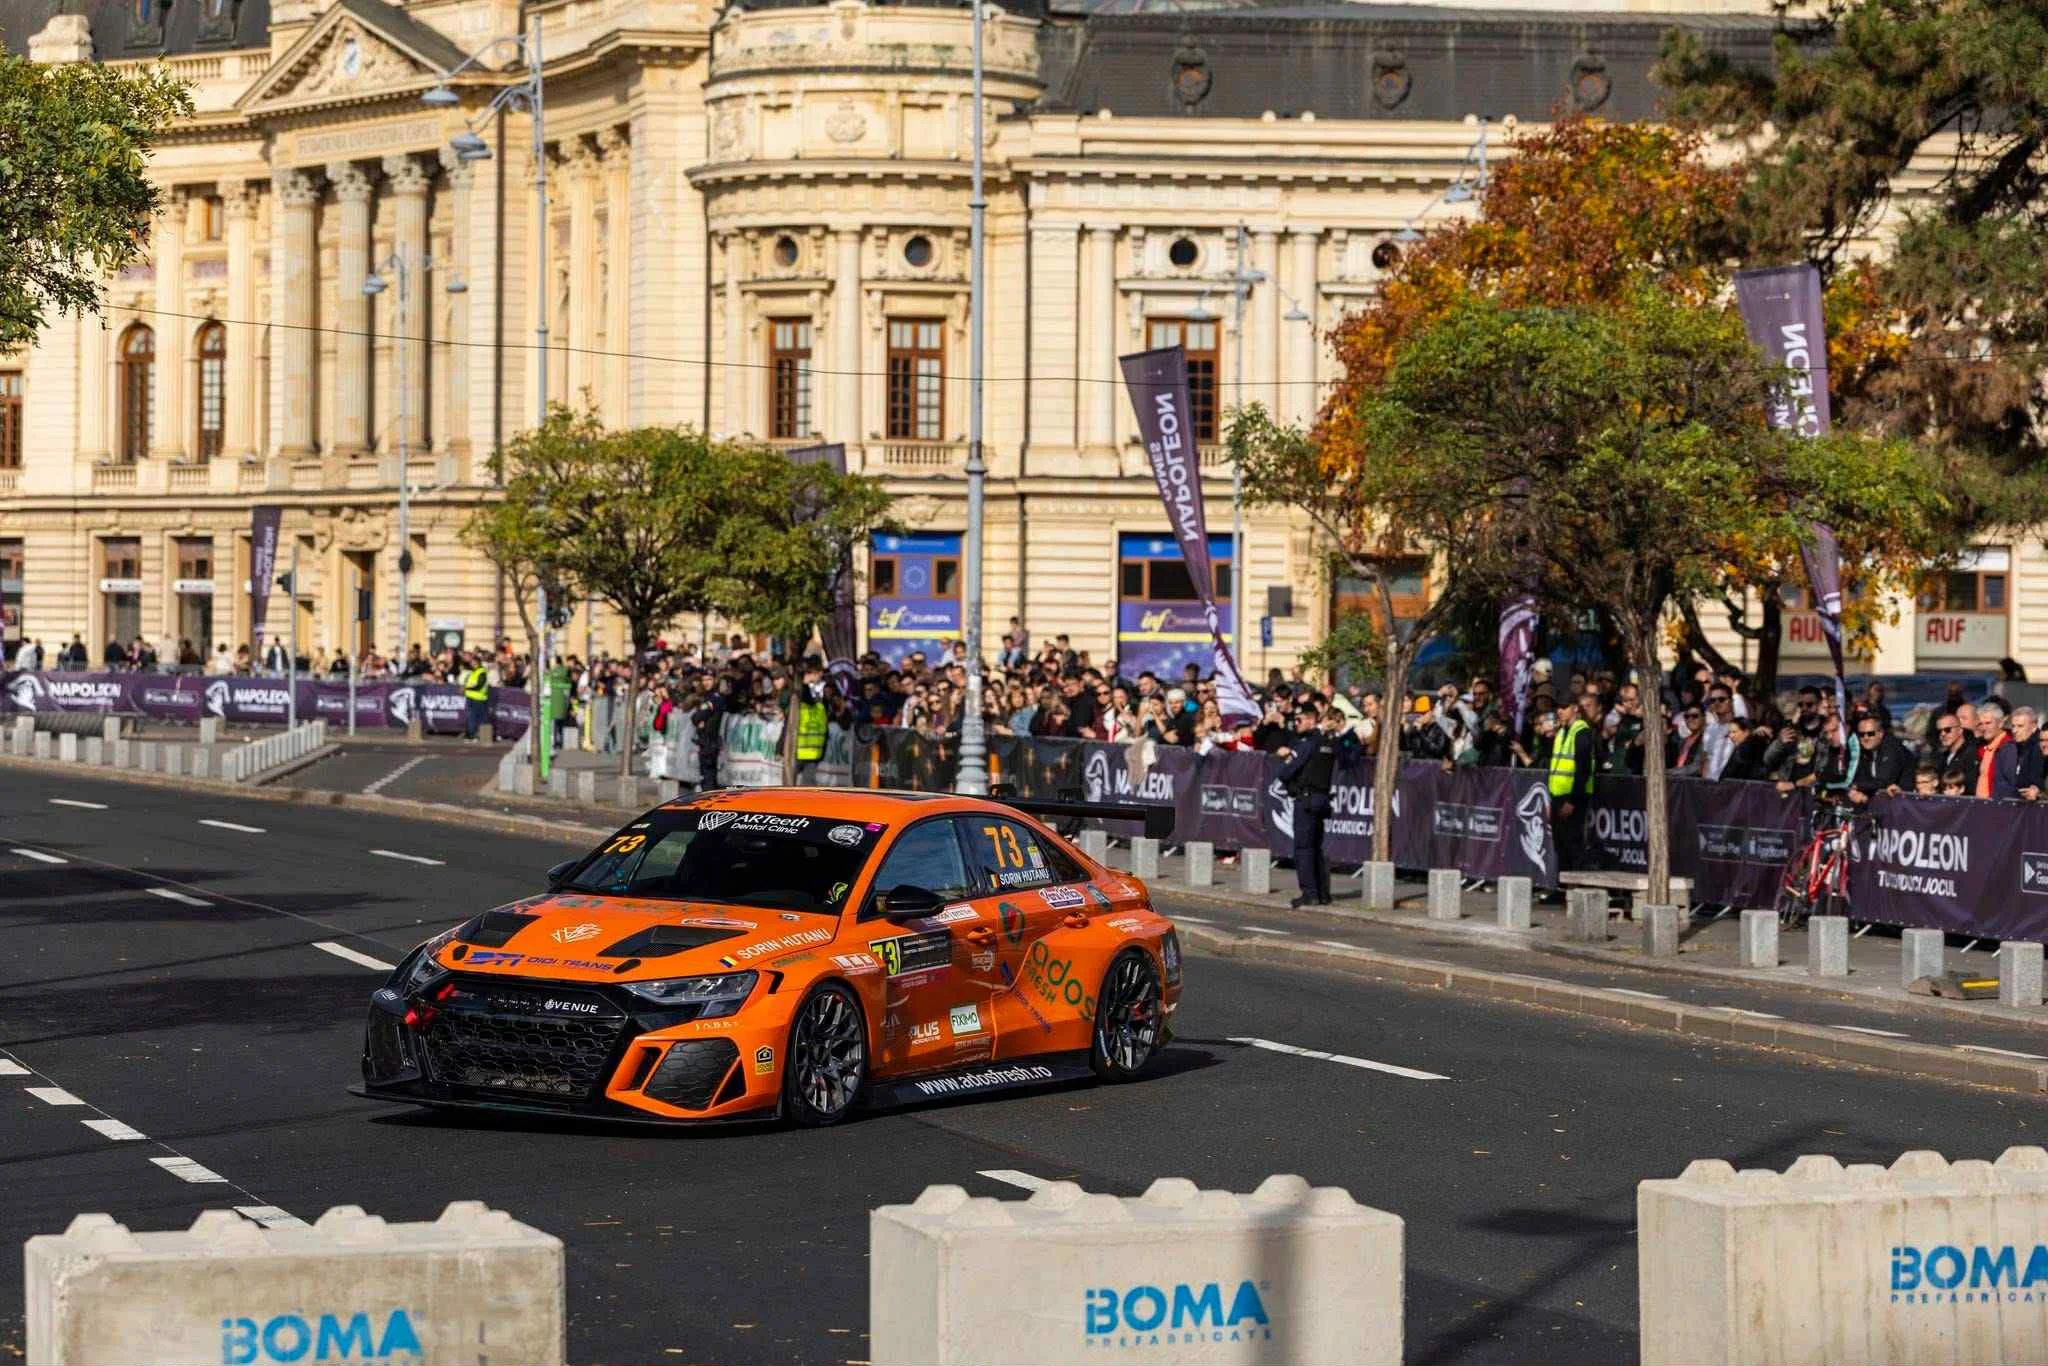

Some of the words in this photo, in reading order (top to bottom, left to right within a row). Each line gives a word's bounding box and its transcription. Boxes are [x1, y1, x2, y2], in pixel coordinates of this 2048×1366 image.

[1790, 617, 1824, 642] AU
[730, 822, 767, 831] Dental
[767, 825, 799, 834] Clinic
[734, 814, 810, 828] ARTeeth
[1586, 808, 1647, 842] POLEO
[603, 834, 647, 854] 73
[983, 824, 1024, 869] 73
[1868, 828, 1968, 872] NAPOLEON
[1000, 870, 1022, 886] SORIN
[1021, 868, 1049, 882] HUTANU
[1922, 877, 1958, 897] JOCUL
[736, 939, 782, 960] SORIN
[781, 927, 832, 946] HUTANU
[951, 1011, 977, 1026] FIXIMO
[914, 1065, 1052, 1095] www.adosfresh.ro
[1891, 1244, 2048, 1291] BOMA
[1085, 1281, 1270, 1335] BOMA
[1891, 1292, 2047, 1304] PREFABRICAT
[221, 1309, 424, 1366] BOMA
